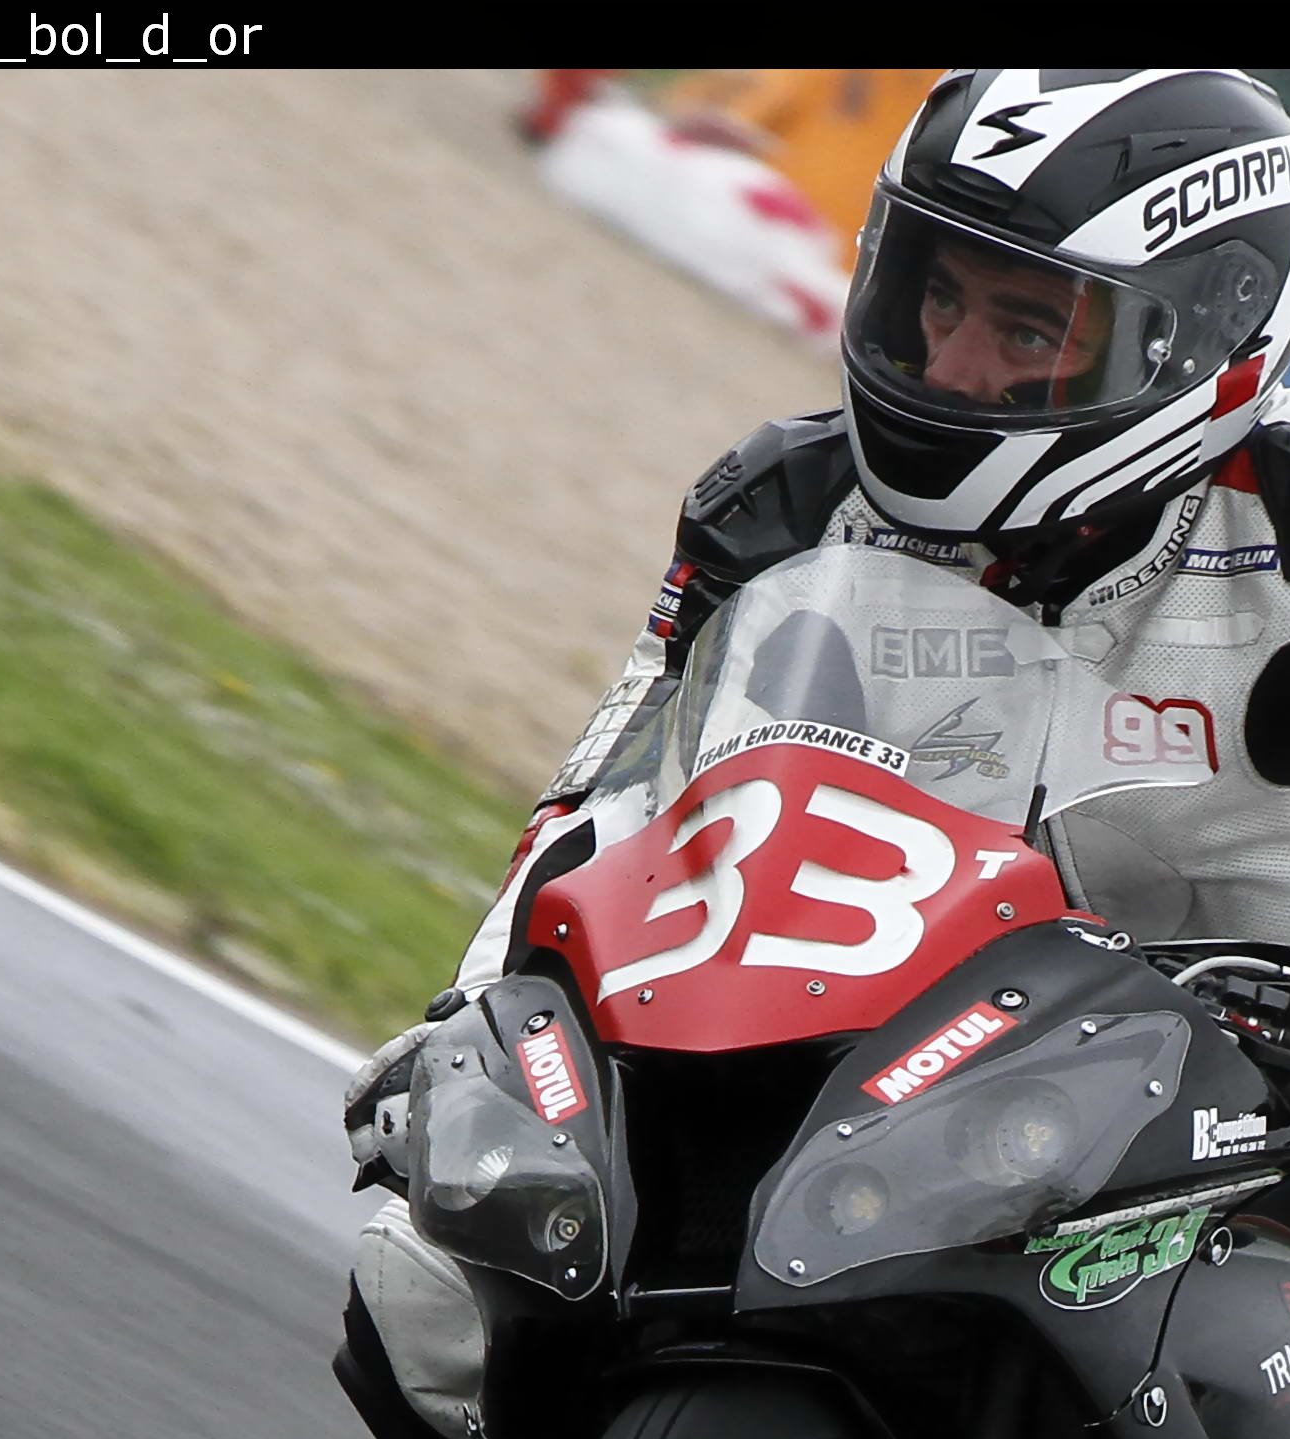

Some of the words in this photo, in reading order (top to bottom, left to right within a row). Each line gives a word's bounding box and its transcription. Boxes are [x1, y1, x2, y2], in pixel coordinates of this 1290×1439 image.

[1116, 494, 1203, 599] BERING
[1185, 550, 1276, 570] MICELIN
[695, 733, 741, 772] TEAM
[745, 721, 874, 758] ENDURANCE
[877, 746, 905, 771] 33
[1104, 692, 1220, 775] 99
[596, 779, 956, 1006] 33
[973, 849, 1018, 880] T
[522, 1032, 578, 1122] MOTUL
[875, 1011, 1005, 1103] MOTUL
